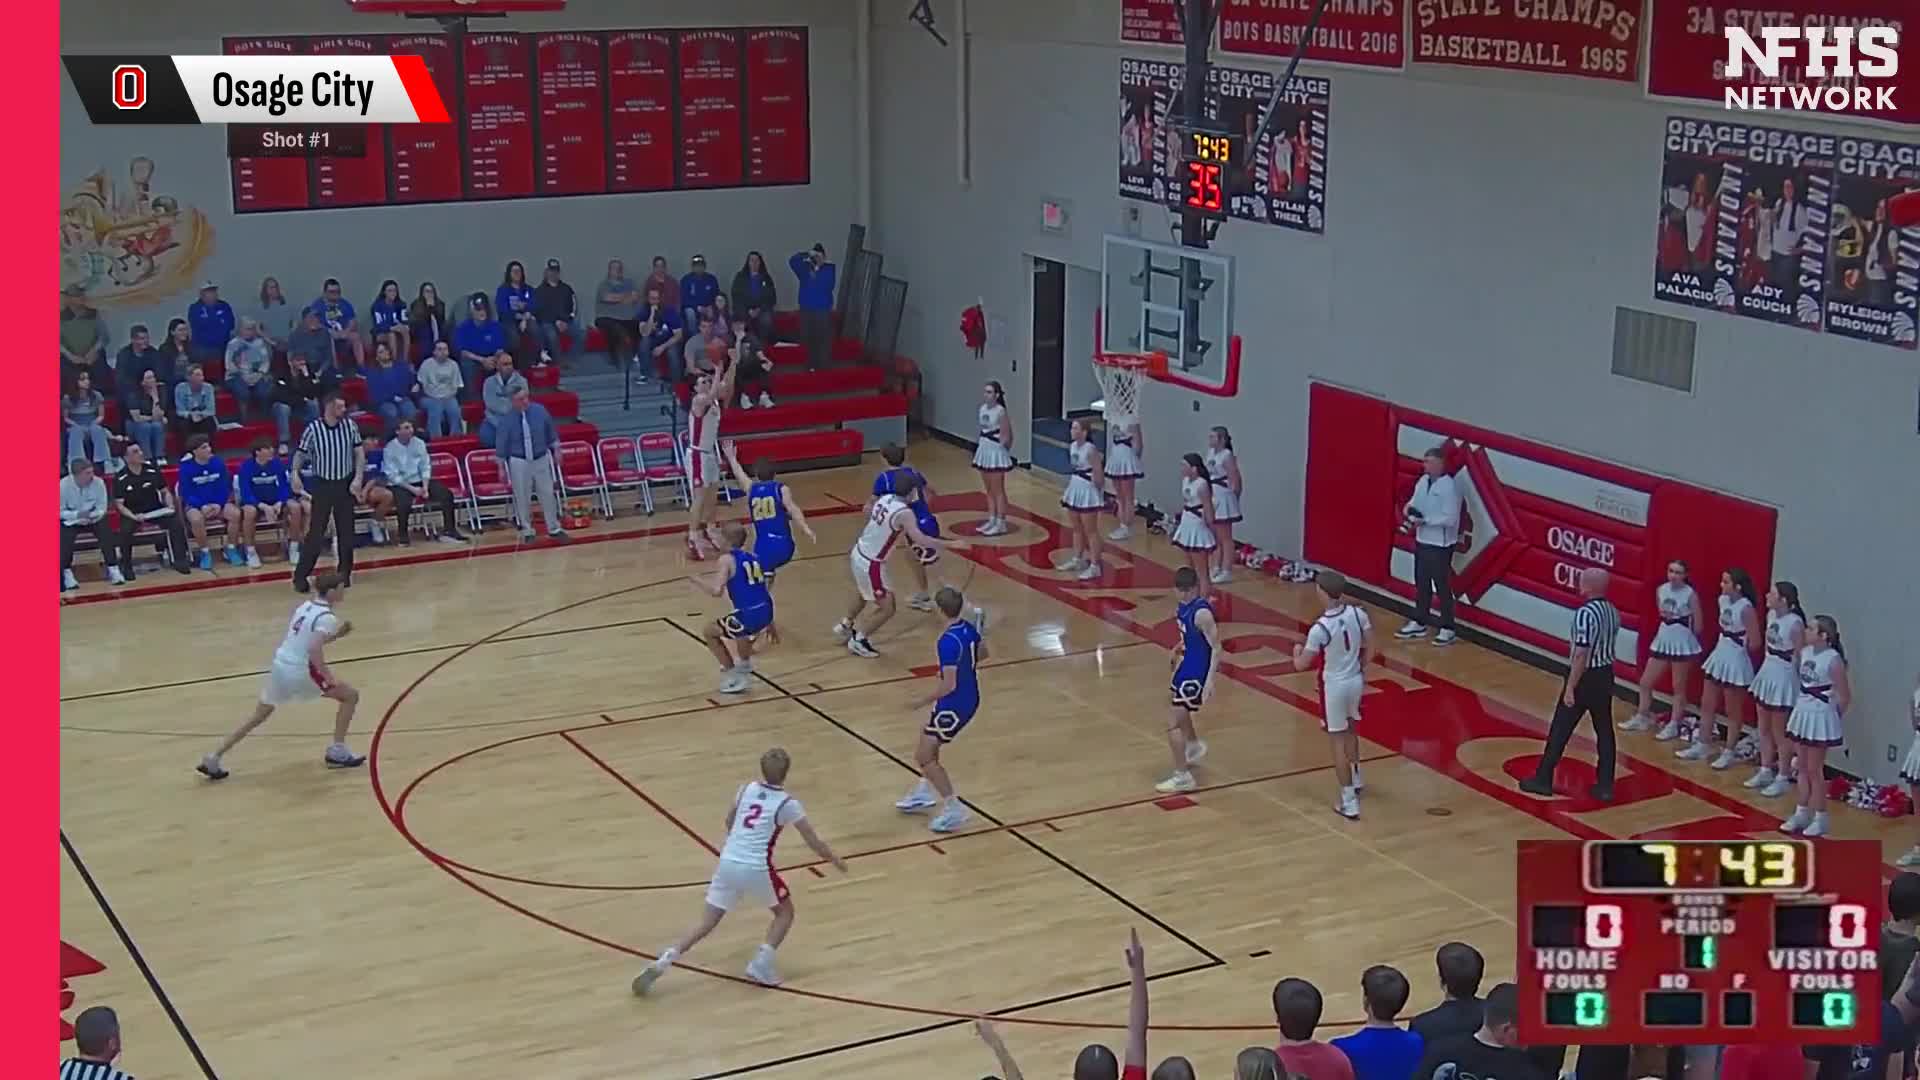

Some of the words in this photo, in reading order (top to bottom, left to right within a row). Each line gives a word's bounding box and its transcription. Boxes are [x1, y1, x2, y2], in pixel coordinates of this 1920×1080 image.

[1418, 0, 1501, 28] STATE
[1514, 0, 1636, 42] CHAMPS
[1224, 20, 1259, 41] BOYS
[1264, 23, 1354, 51] BASKTBALL
[1361, 31, 1398, 54] 2016
[1420, 34, 1567, 68] BASKETBALL
[1580, 46, 1628, 74] 1965
[1121, 73, 1152, 87] CITY
[1122, 60, 1167, 77] OSAGE
[1220, 70, 1272, 88] OSAGE
[1220, 83, 1254, 99] CITY
[1668, 119, 1748, 145] OSAGE
[1750, 129, 1835, 156] OSAGE
[1193, 134, 1230, 162] 7:43
[1308, 110, 1327, 203] INDIANS
[1667, 135, 1720, 157] CITY
[1750, 146, 1806, 169] CITY
[1839, 157, 1901, 181] CITY
[1187, 163, 1222, 210] 35
[1272, 199, 1306, 213] DYLAN
[1714, 162, 1743, 276] INDIANS
[1799, 175, 1830, 292] INDIANS
[1672, 272, 1701, 287] AVA
[1752, 284, 1784, 299] ADY
[1657, 283, 1714, 301] PALACIO
[1743, 297, 1792, 315] COUCH
[1831, 315, 1889, 336] BROWN
[751, 495, 777, 520] 20
[1547, 526, 1615, 567] OSAGE
[1343, 630, 1351, 652] 1
[743, 803, 763, 829] 2
